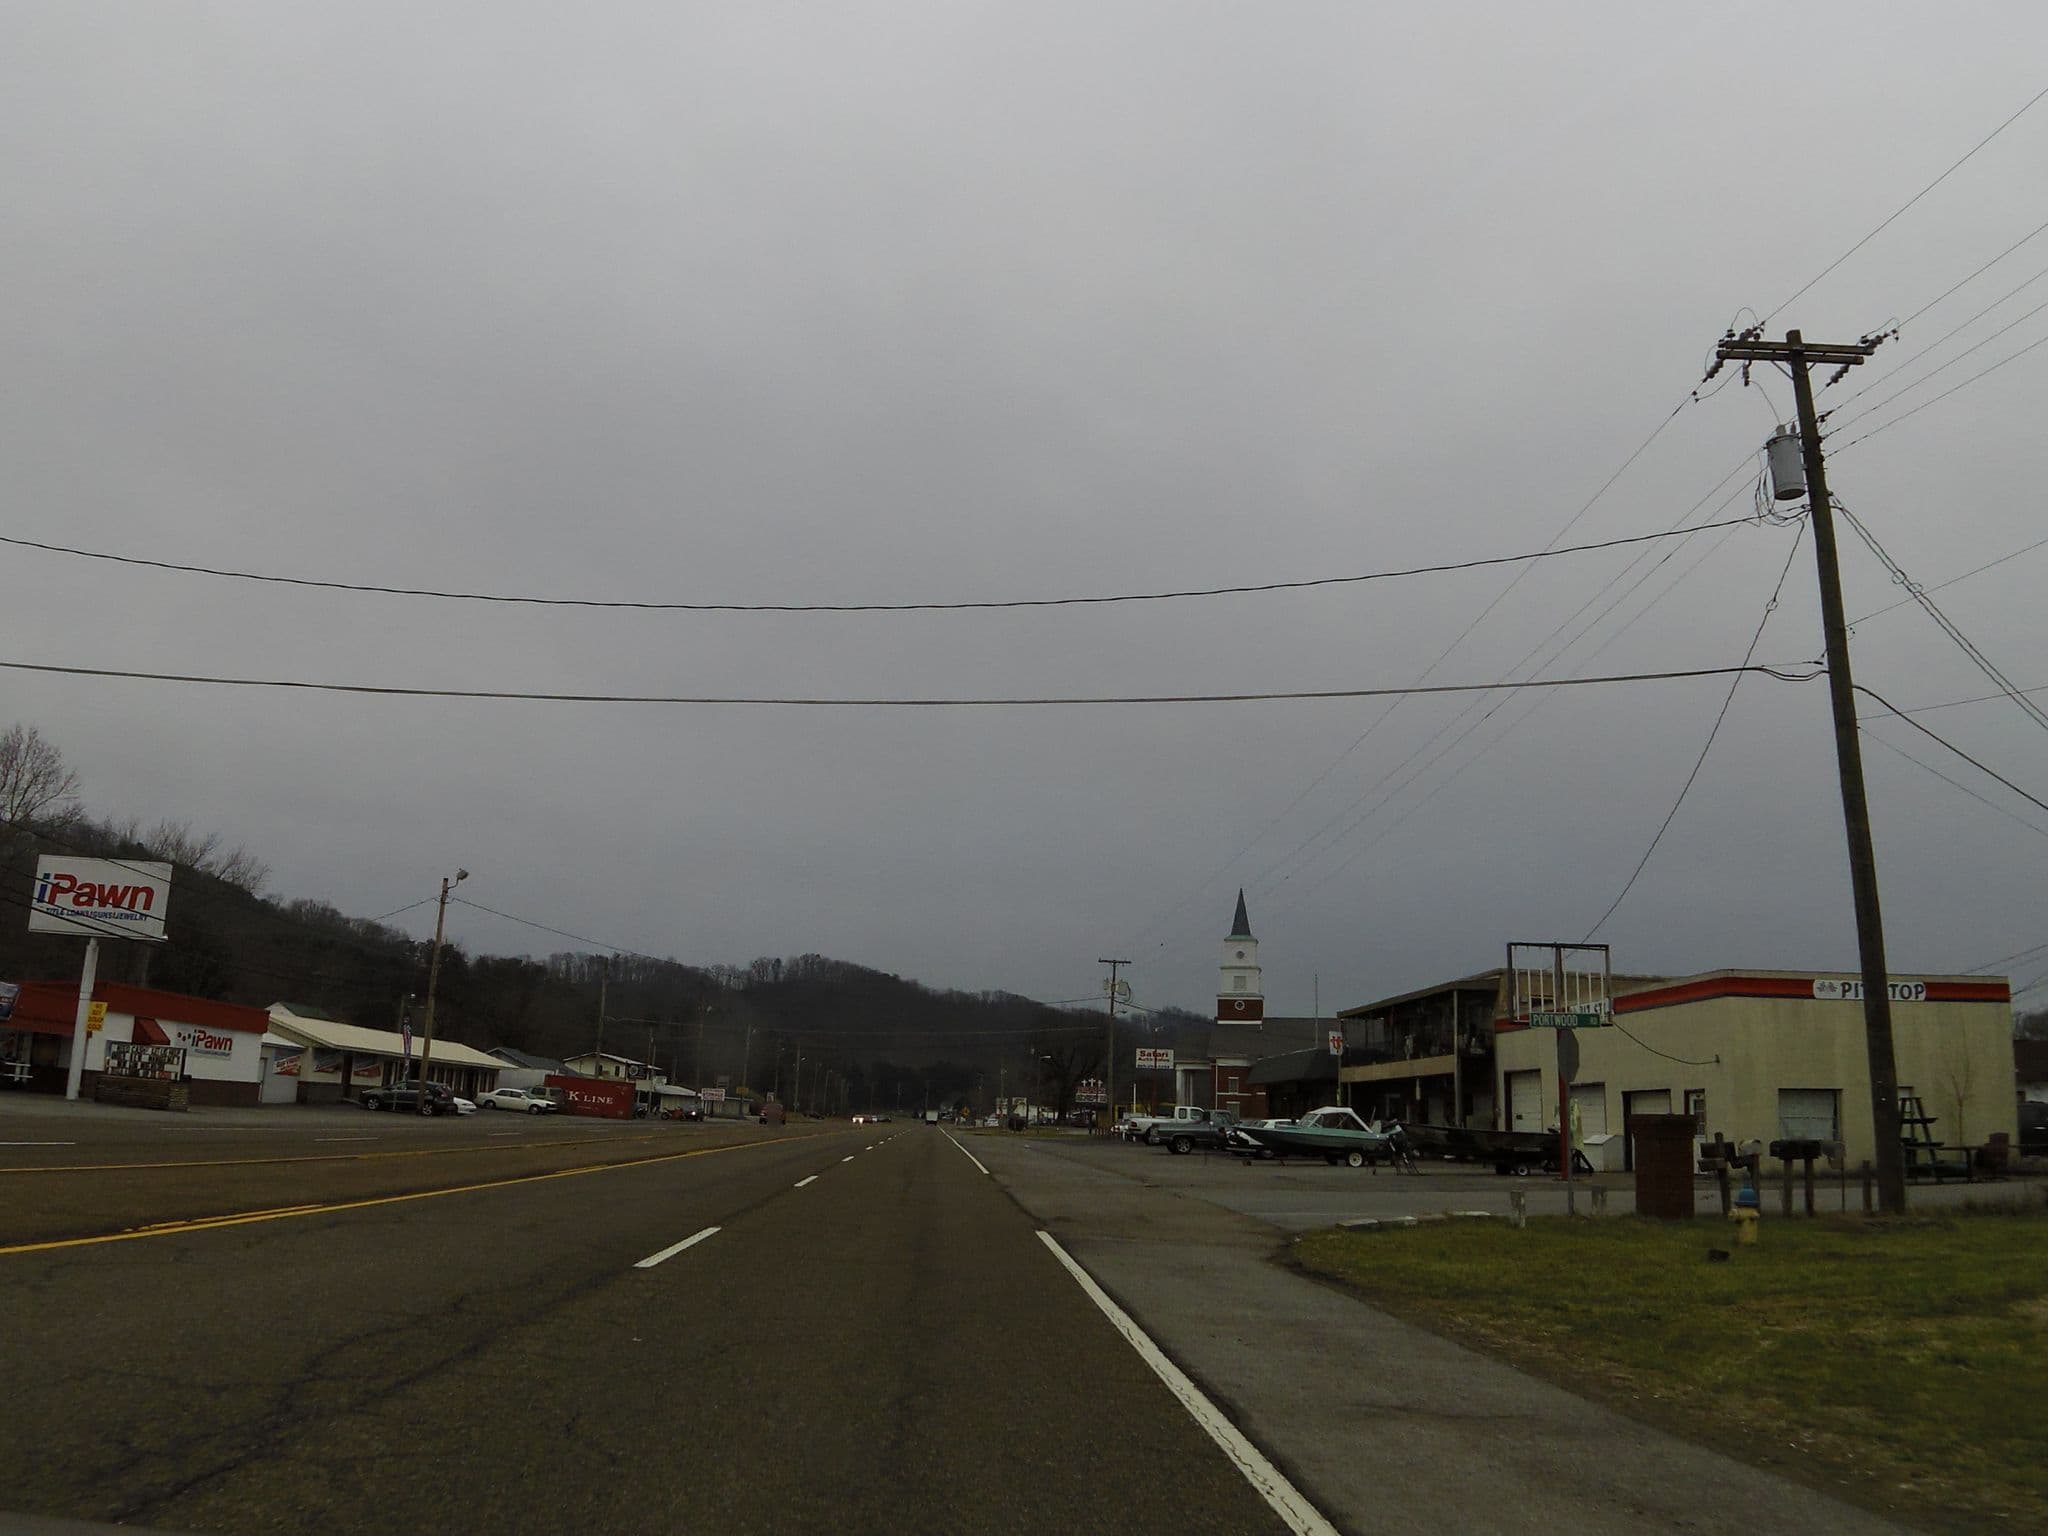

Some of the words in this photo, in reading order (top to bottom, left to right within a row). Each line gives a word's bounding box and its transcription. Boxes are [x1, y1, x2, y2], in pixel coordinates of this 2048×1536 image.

[37, 873, 155, 911] iPawn
[1888, 983, 1925, 1000] TOP
[1533, 1014, 1578, 1026] PORTWOOD
[191, 1029, 233, 1051] iPawn
[568, 1091, 579, 1101] K
[583, 1095, 614, 1105] LINE
